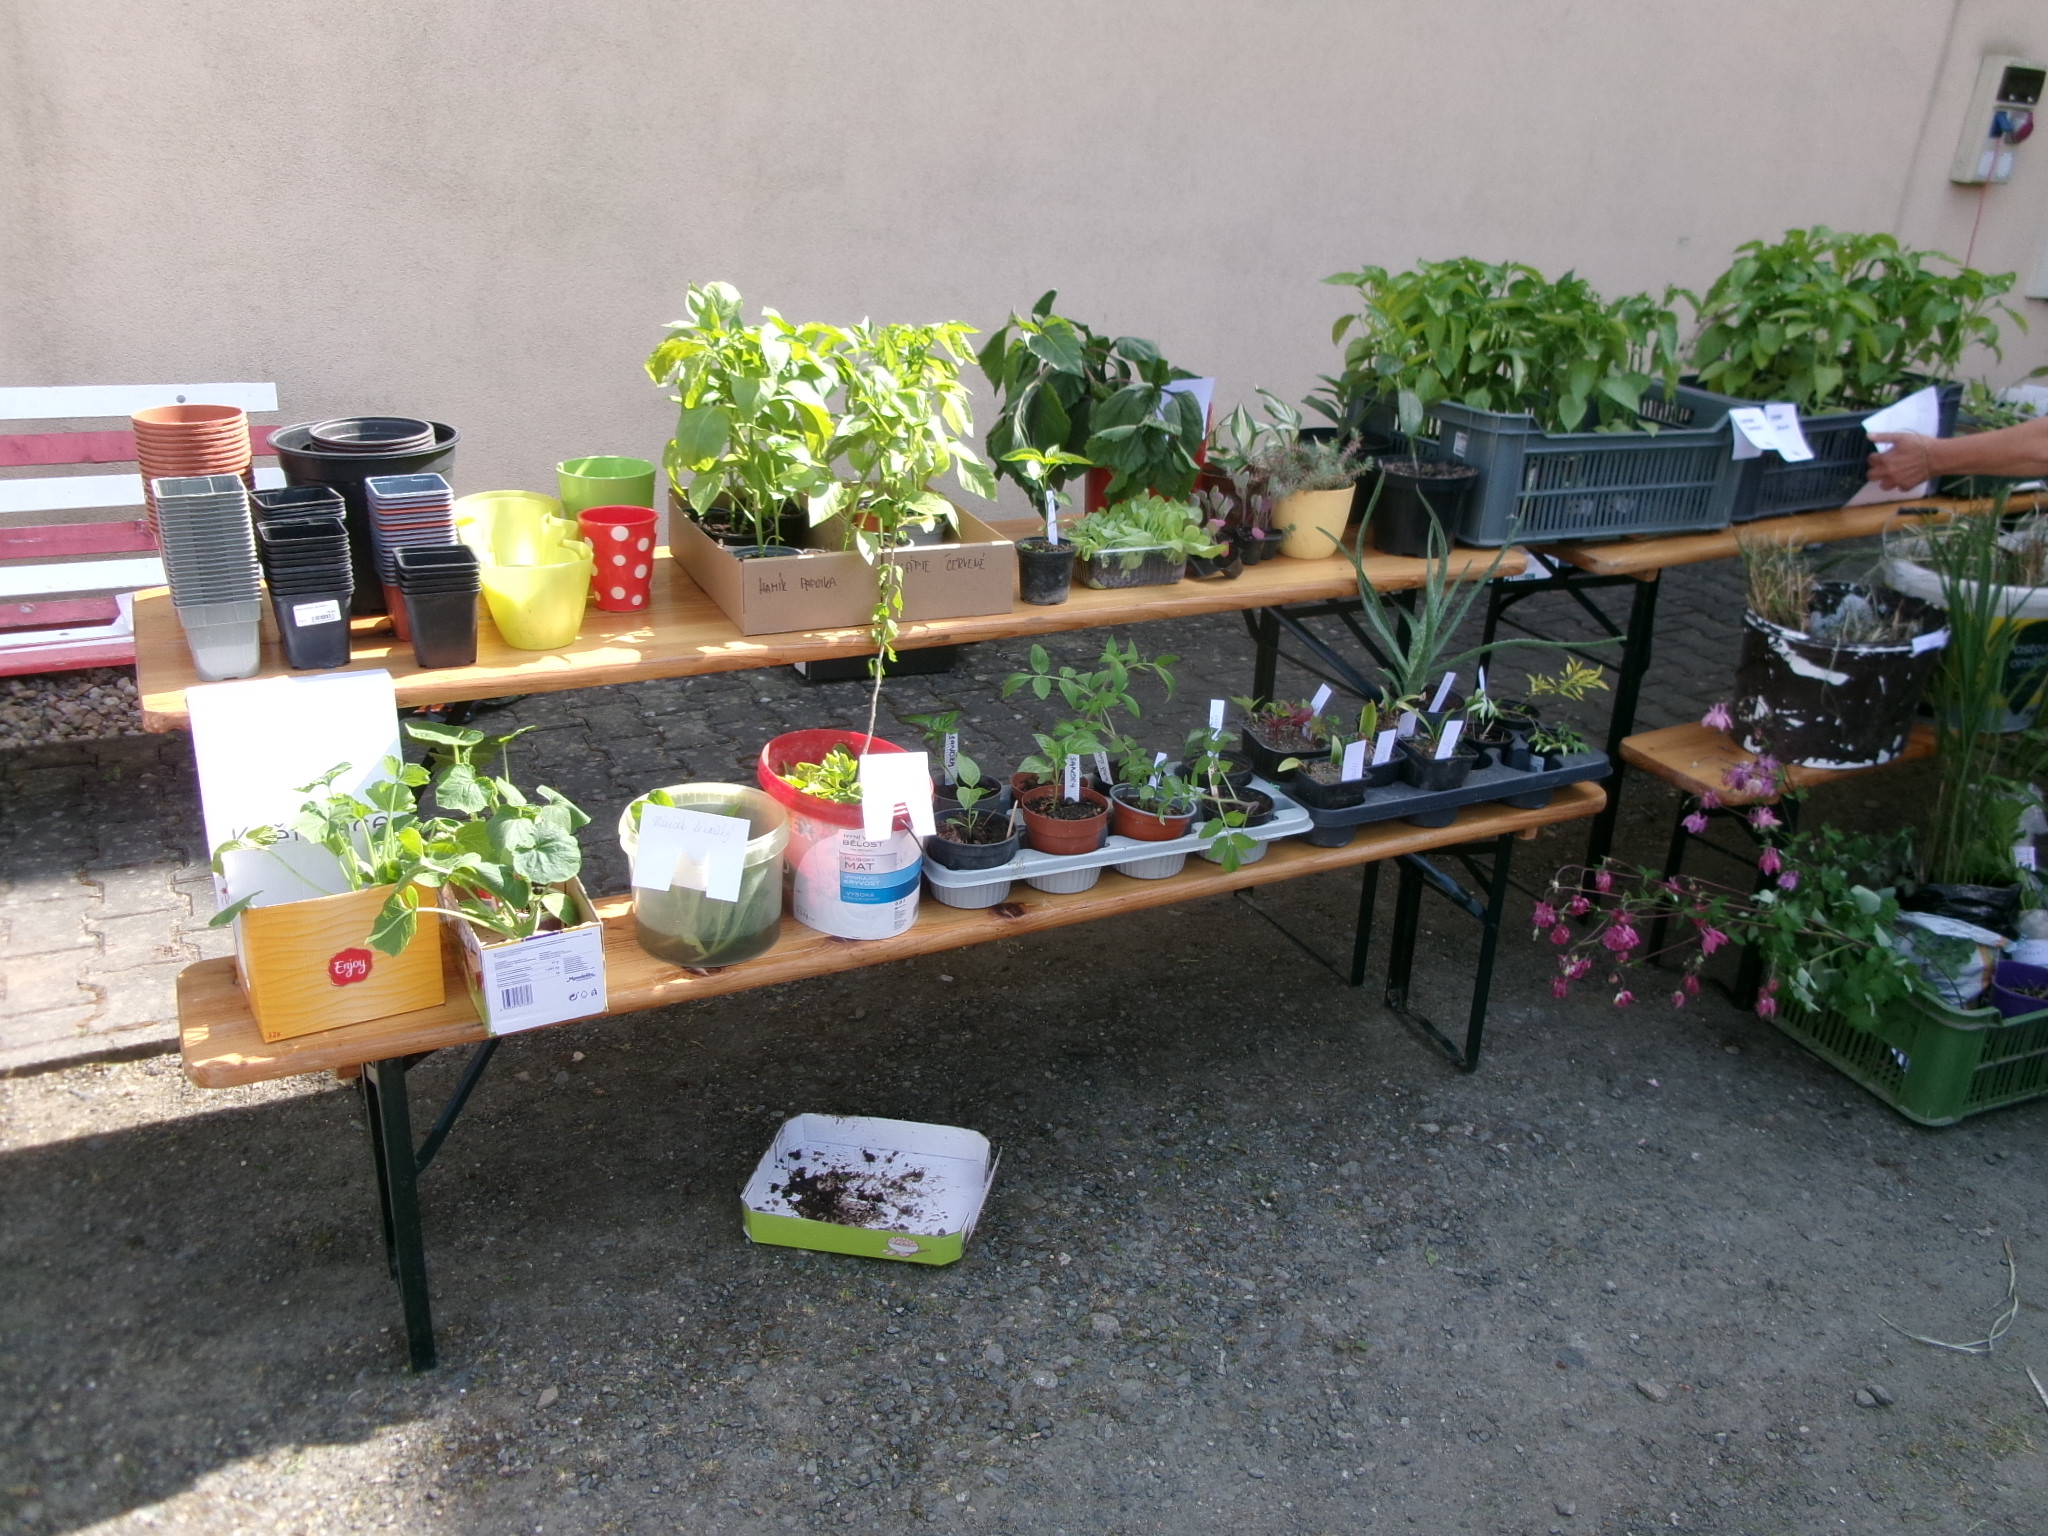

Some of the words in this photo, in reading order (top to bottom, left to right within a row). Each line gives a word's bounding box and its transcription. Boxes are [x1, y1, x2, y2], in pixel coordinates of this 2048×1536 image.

[842, 839, 884, 848] BĚLOST
[844, 862, 875, 871] MAT
[334, 958, 367, 977] Enjoy
